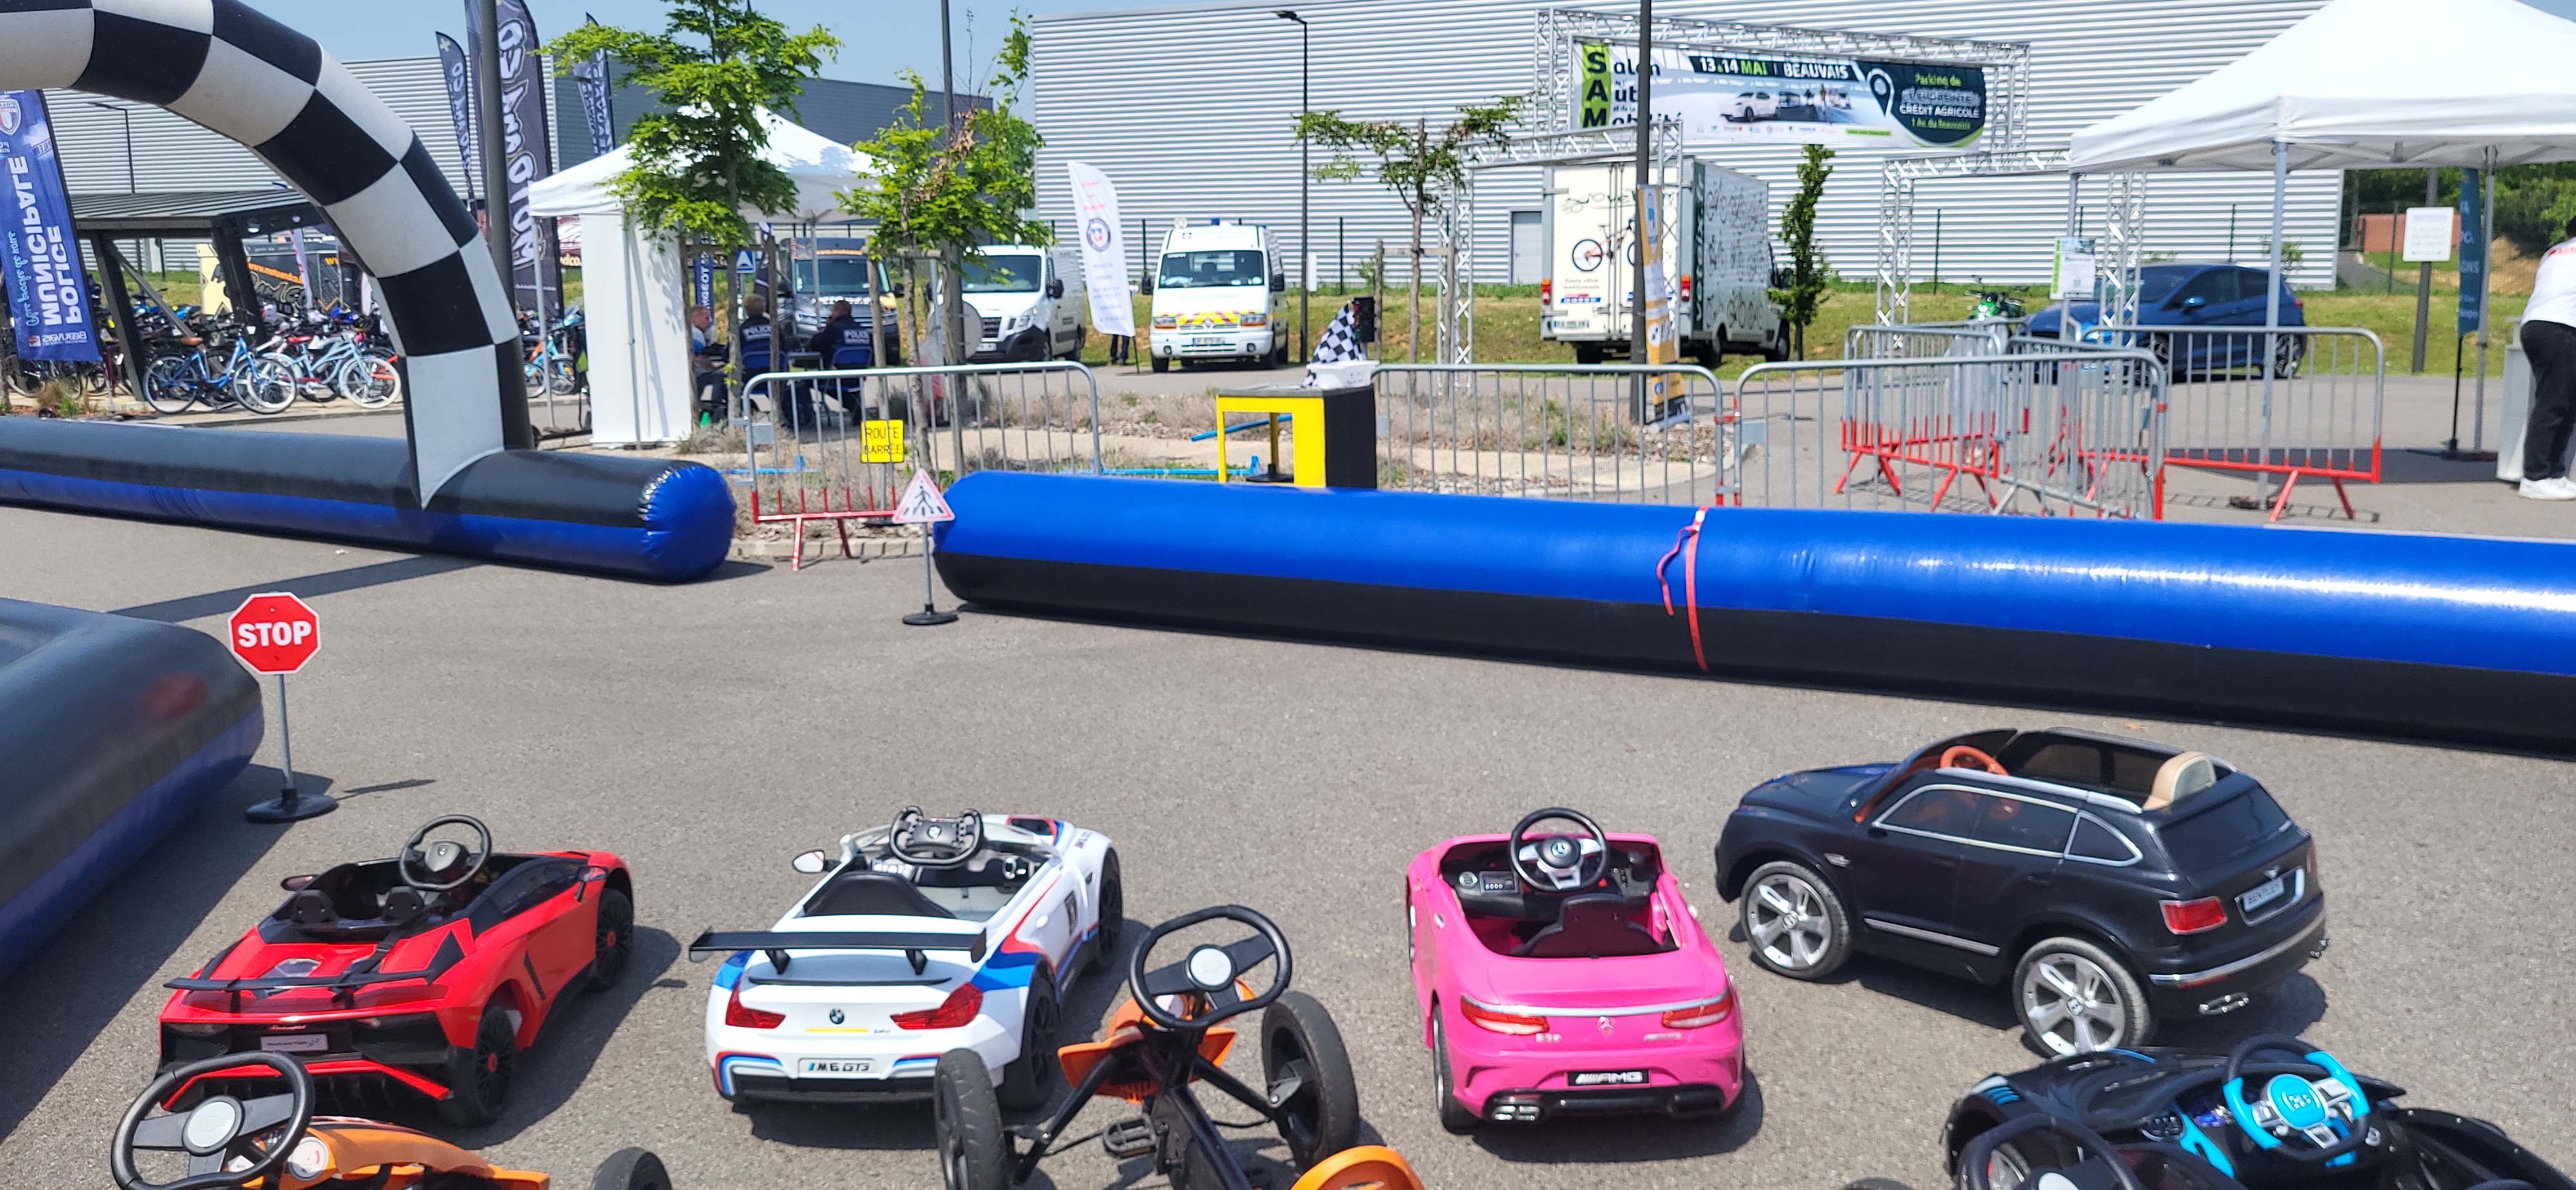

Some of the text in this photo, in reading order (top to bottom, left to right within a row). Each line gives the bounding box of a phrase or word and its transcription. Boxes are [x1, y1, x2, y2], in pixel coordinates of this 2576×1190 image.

[1740, 60, 1768, 76] MAI
[1783, 62, 1849, 80] BEAUVAIS
[1915, 72, 1962, 88] Parking de
[1900, 102, 1980, 118] CRÉDIT AGRICOLE
[238, 620, 312, 648] STOP
[842, 1062, 869, 1072] GT3
[1597, 1071, 1643, 1082] AMG
